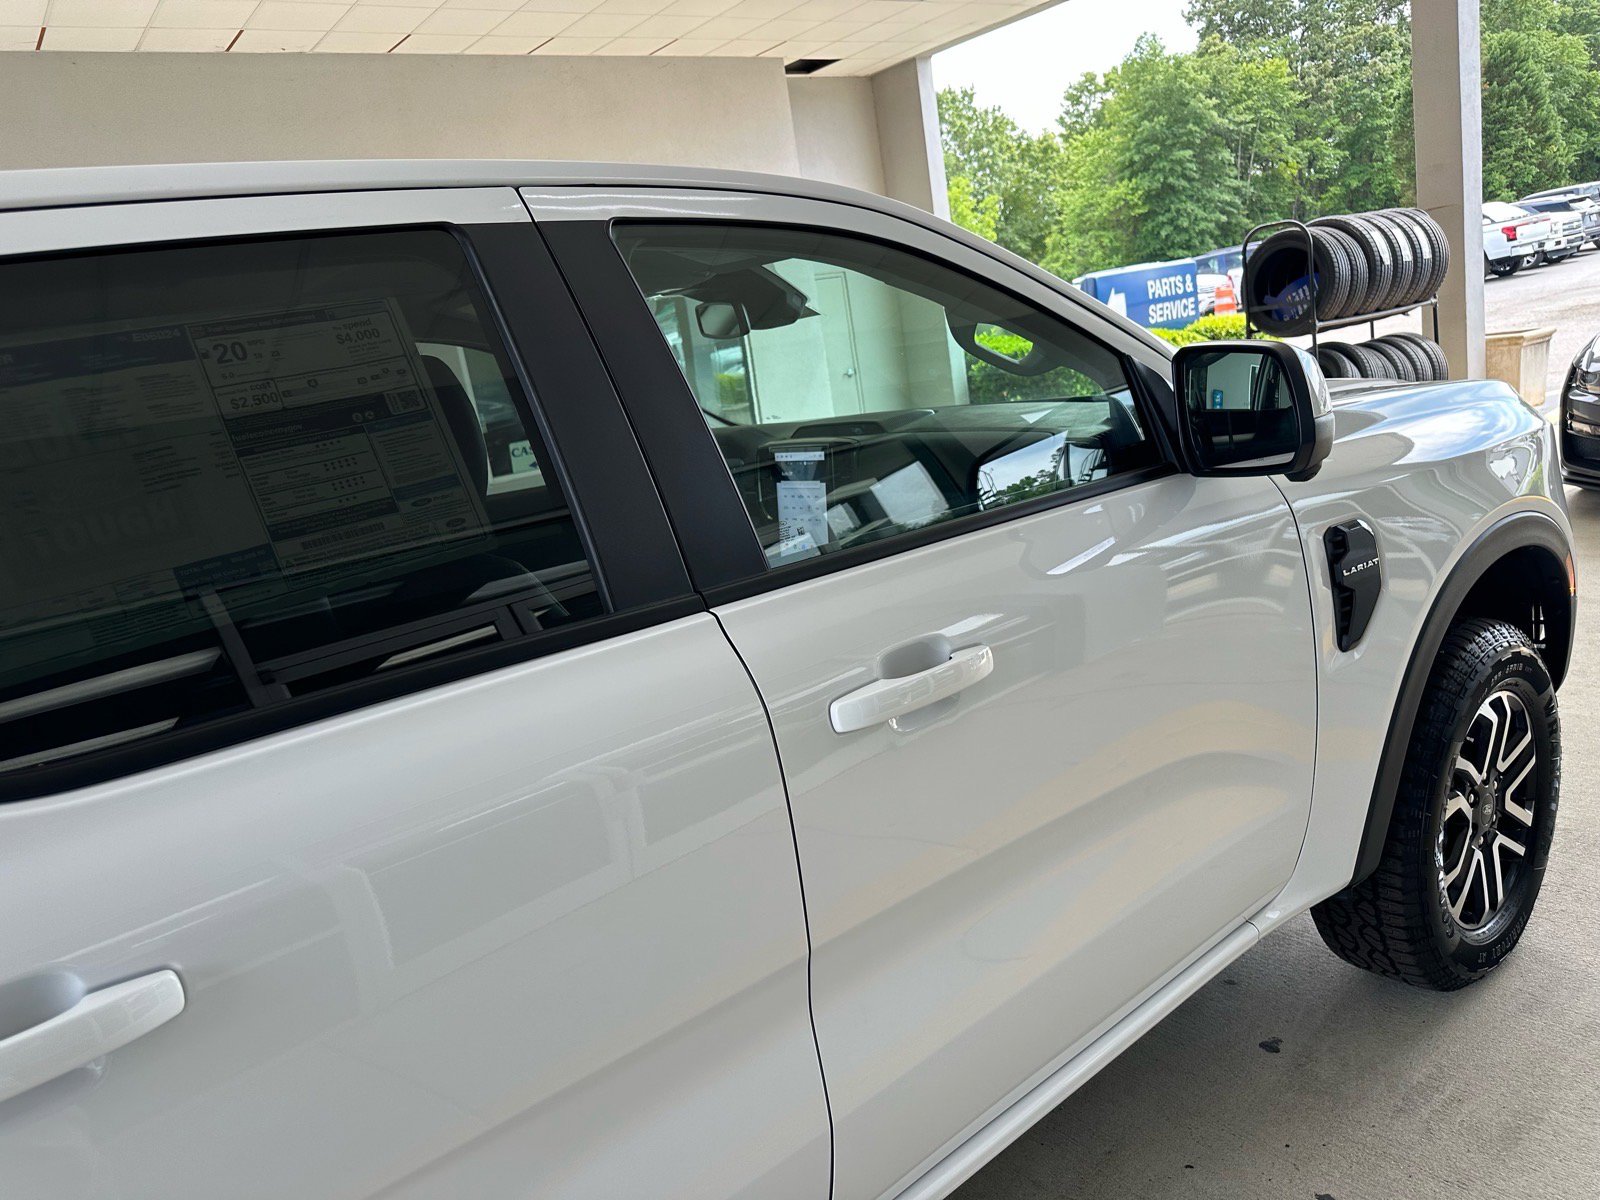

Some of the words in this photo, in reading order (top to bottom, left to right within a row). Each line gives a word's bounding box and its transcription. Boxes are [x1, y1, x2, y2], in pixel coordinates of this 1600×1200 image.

[1146, 274, 1184, 300] PARTS
[1184, 273, 1194, 293] &
[1148, 296, 1197, 325] SERVICE
[335, 327, 381, 345] $4,000
[211, 340, 248, 365] 20
[230, 391, 279, 411] $2,500
[1342, 557, 1379, 577] LARIAT
